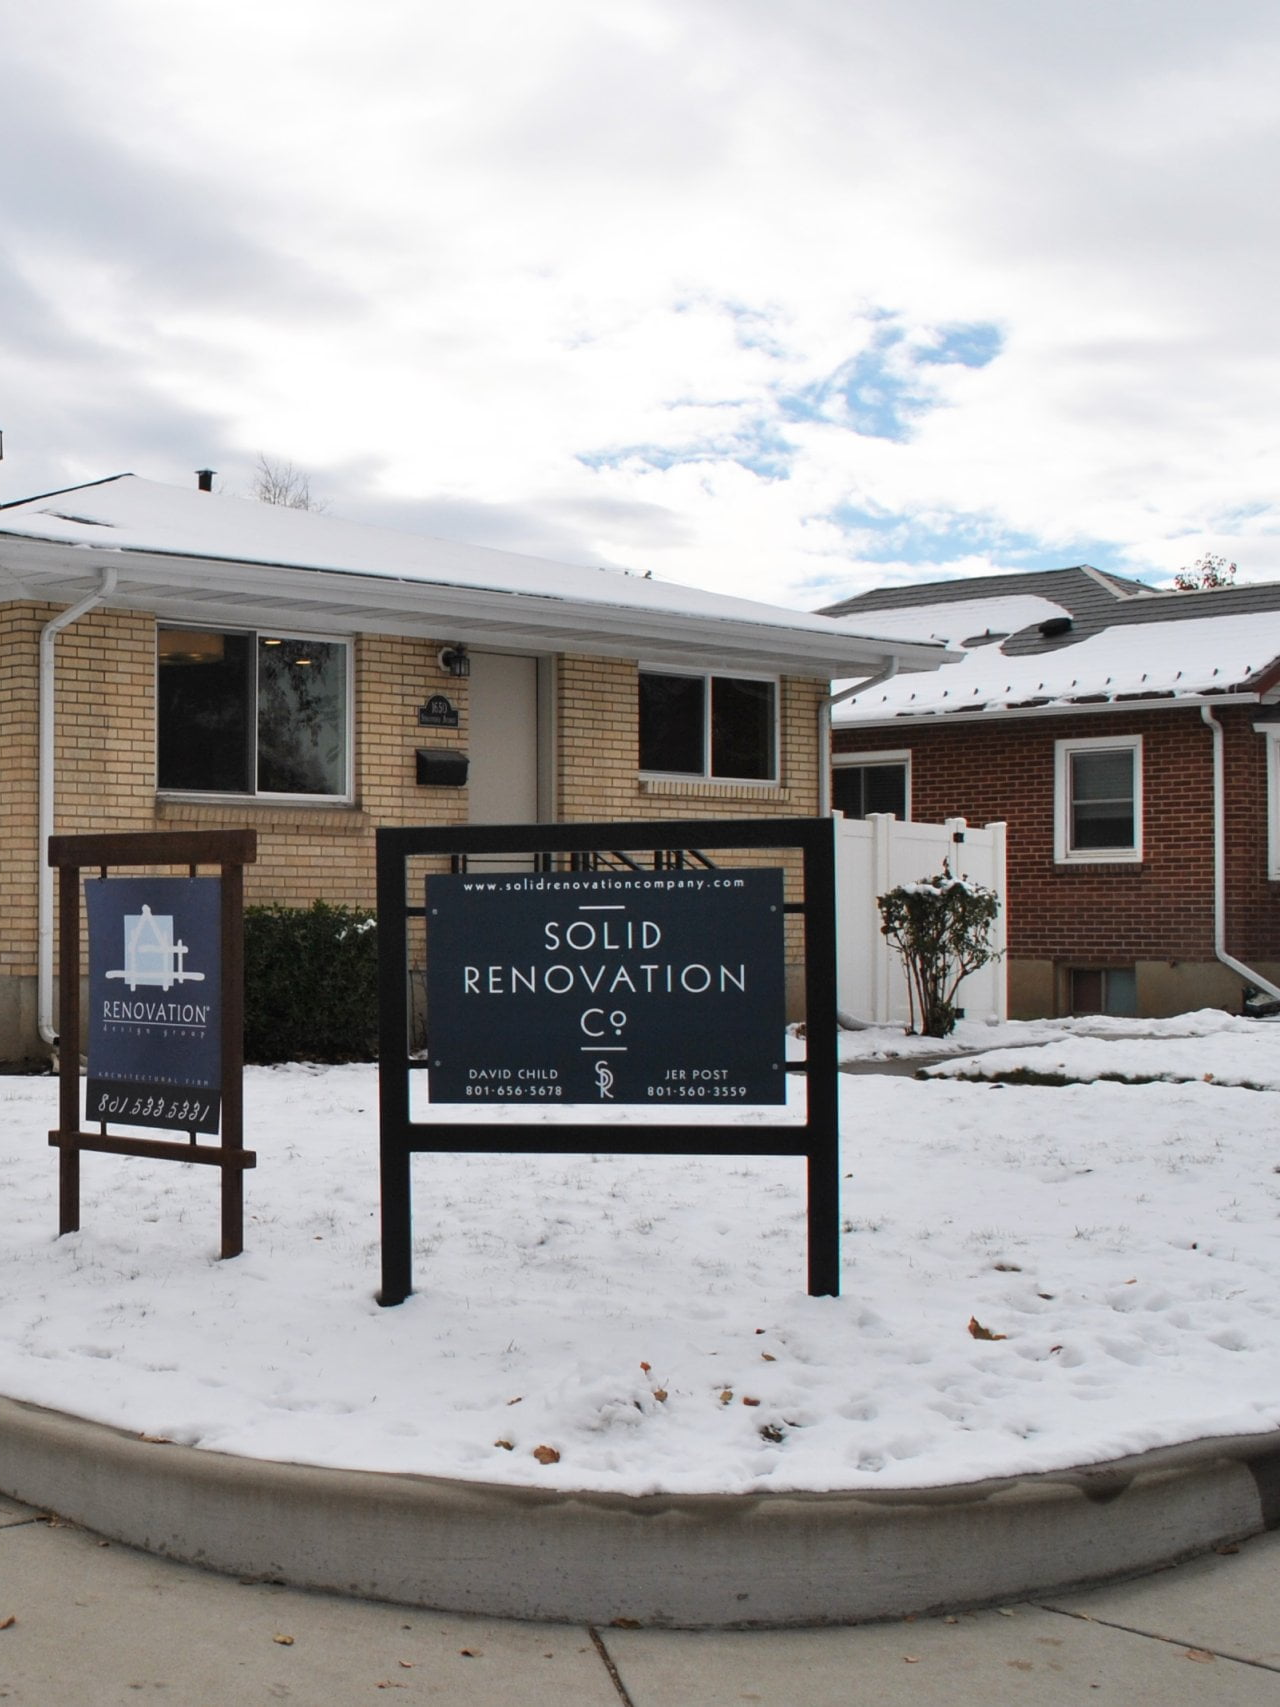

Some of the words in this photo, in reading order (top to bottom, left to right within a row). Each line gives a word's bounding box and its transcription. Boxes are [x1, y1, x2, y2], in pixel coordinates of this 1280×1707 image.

[463, 876, 745, 891] www.solidrenovationcompany.com
[544, 921, 662, 951] SOLID
[464, 963, 746, 994] RENOVATION
[103, 1023, 151, 1036] design
[163, 1029, 206, 1039] group
[98, 1071, 178, 1084] ARCHITECTURAL
[185, 1078, 209, 1087] FIRM
[468, 1069, 512, 1080] DAVID
[517, 1069, 559, 1080] CHILD
[664, 1069, 687, 1080] JER
[692, 1069, 729, 1080] POST
